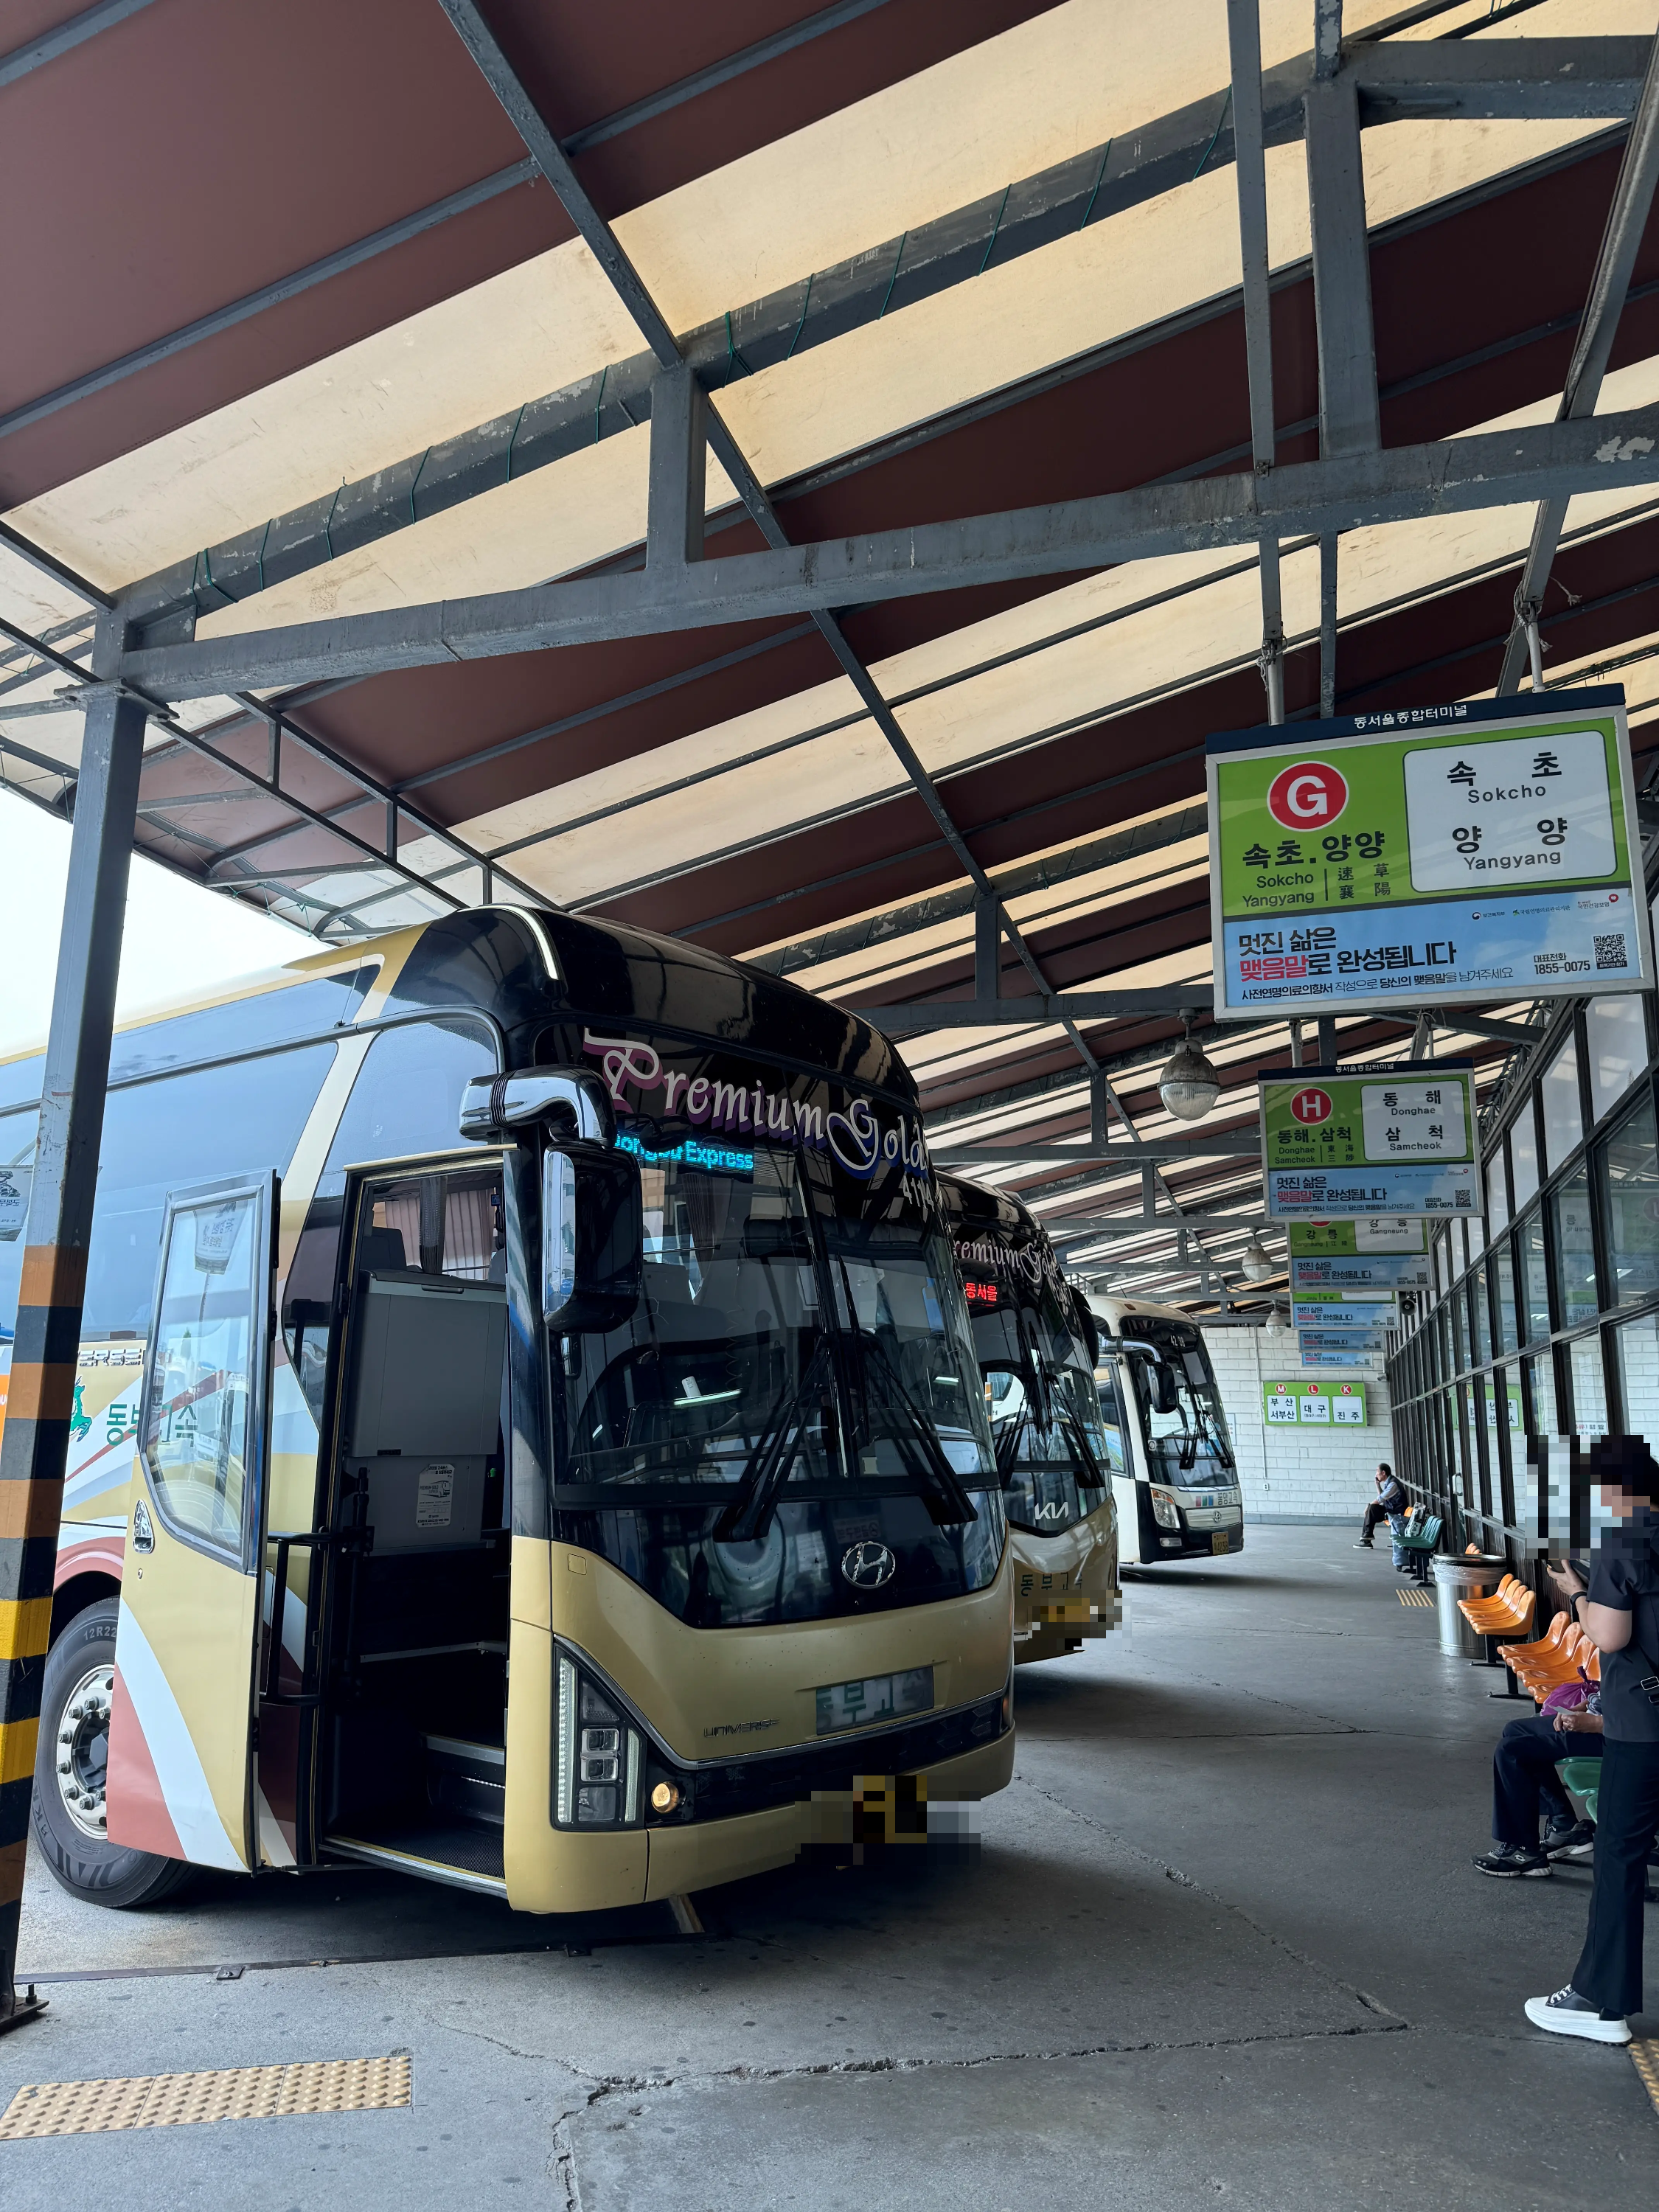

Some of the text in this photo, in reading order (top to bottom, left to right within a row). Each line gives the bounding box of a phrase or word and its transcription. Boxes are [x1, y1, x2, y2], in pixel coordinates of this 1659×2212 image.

[1354, 705, 1467, 728] 동서울종합터미널
[1287, 775, 1327, 817] G
[1468, 785, 1546, 803] Sokcho
[1464, 852, 1561, 870] Yangyang
[1256, 873, 1314, 888] Sokcho
[1242, 892, 1314, 907] Yangyang
[1239, 927, 1336, 956] 멋진 삶은
[1240, 942, 1456, 982] 맺음말로 완성됩니다
[1534, 953, 1567, 963] 대표전화
[1534, 961, 1590, 975] 1855-0075
[1242, 967, 1513, 1000] 사전연명의료의향서 작성으로 당신의 맺음말을 남겨주세요
[583, 1027, 928, 1175] Premium Gold
[1302, 1095, 1321, 1117] H
[1391, 1107, 1436, 1116] Donghae
[686, 1141, 754, 1169] Express
[1279, 1147, 1315, 1155] Donghae
[1390, 1141, 1441, 1151] Samcheok
[903, 1171, 935, 1212] 4114
[1277, 1176, 1327, 1189] 멋진 삶은
[1326, 1188, 1387, 1202] 완성됩니다
[953, 1239, 1020, 1268] remium
[1298, 1262, 1332, 1271] 멋진 삶은
[1332, 1270, 1372, 1279] 완성됩니다
[965, 1282, 998, 1301] 동서울
[78, 1348, 142, 1366] ERSE
[1270, 1411, 1295, 1419] 서부산
